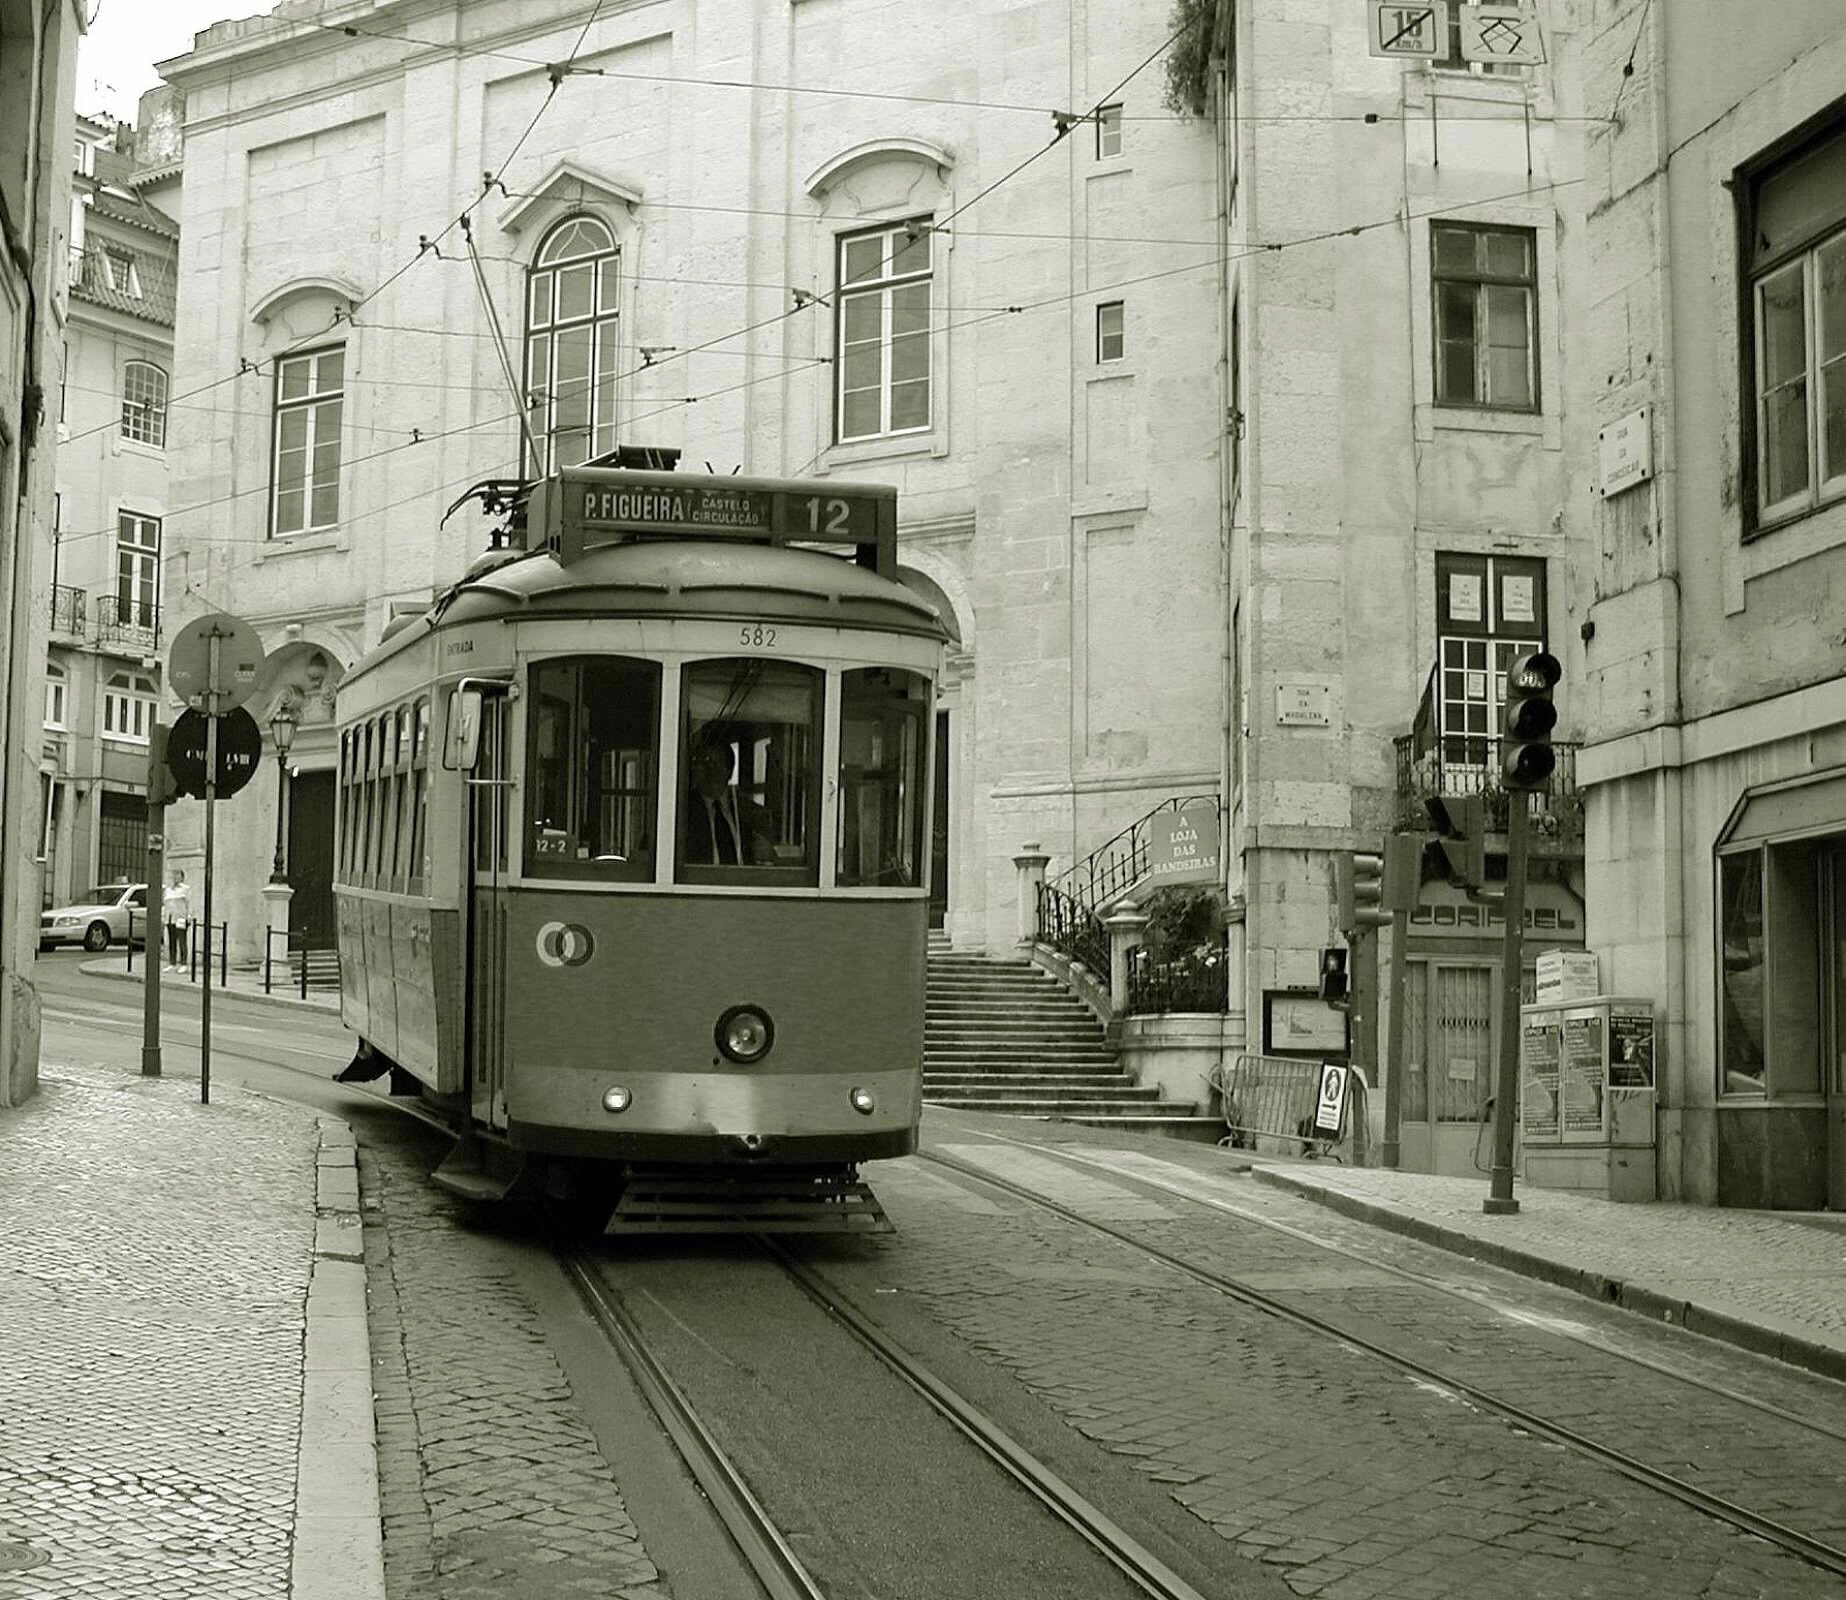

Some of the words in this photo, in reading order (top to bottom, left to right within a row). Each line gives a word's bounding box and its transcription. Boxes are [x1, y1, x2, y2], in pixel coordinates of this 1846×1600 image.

[1391, 11, 1422, 38] 15
[584, 493, 597, 518] P.
[601, 493, 685, 521] FIGUEIRA
[702, 498, 750, 512] CASTELO
[806, 497, 850, 534] 12
[740, 627, 777, 648] 582
[1179, 816, 1188, 827] A
[1169, 829, 1198, 843] LOJA
[1173, 844, 1196, 858] DAS
